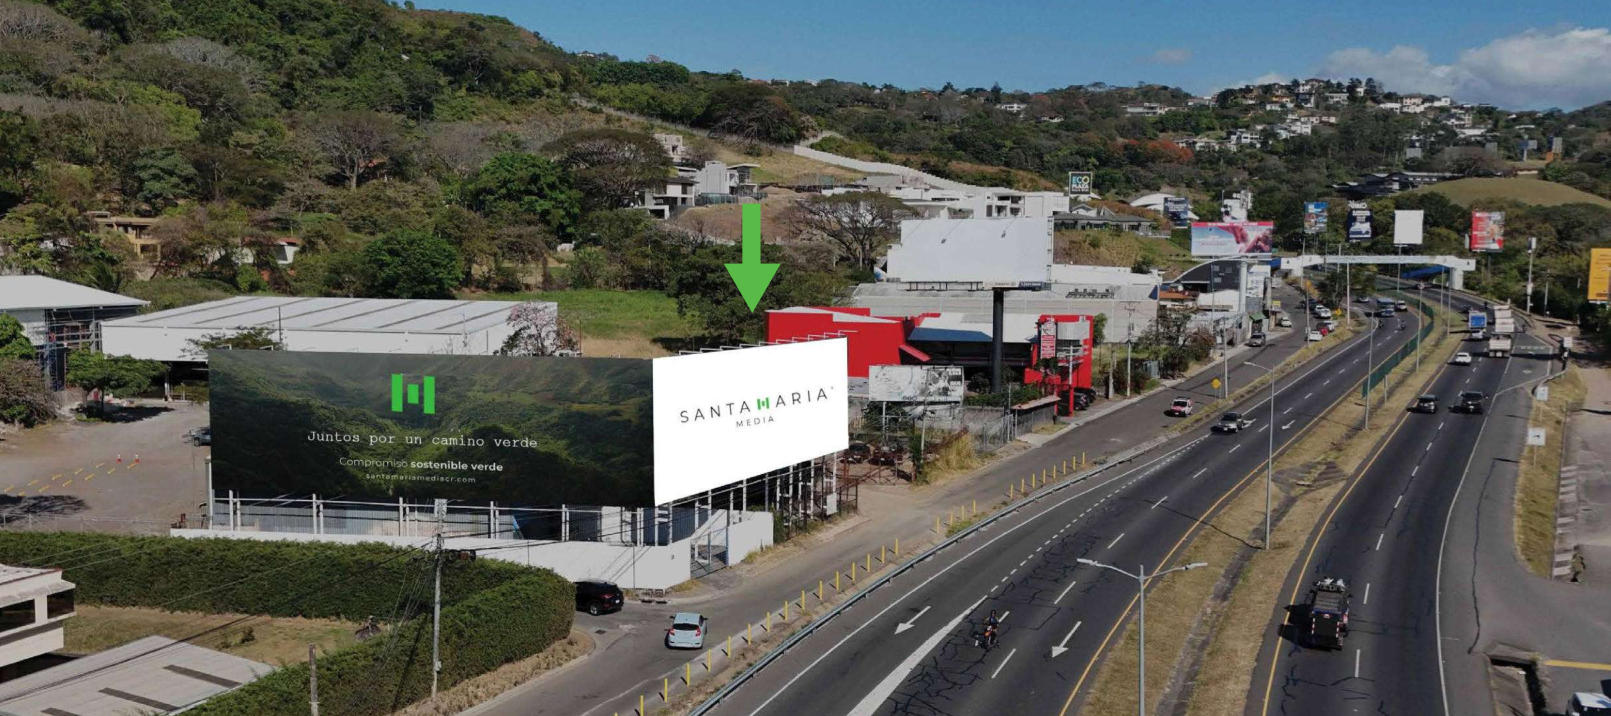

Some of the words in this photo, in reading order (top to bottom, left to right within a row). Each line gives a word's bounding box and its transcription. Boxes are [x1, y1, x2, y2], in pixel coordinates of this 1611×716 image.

[1072, 176, 1090, 184] ECO
[736, 415, 774, 428] MEDIA
[307, 430, 360, 443] Juntos
[369, 434, 396, 446] por
[405, 435, 422, 445] un
[431, 433, 485, 447] camino
[494, 436, 538, 449] verde
[339, 457, 409, 468] Compromiso
[410, 459, 468, 471] sostenible
[470, 461, 503, 472] verde
[365, 473, 476, 483] santamariamediacr.com
